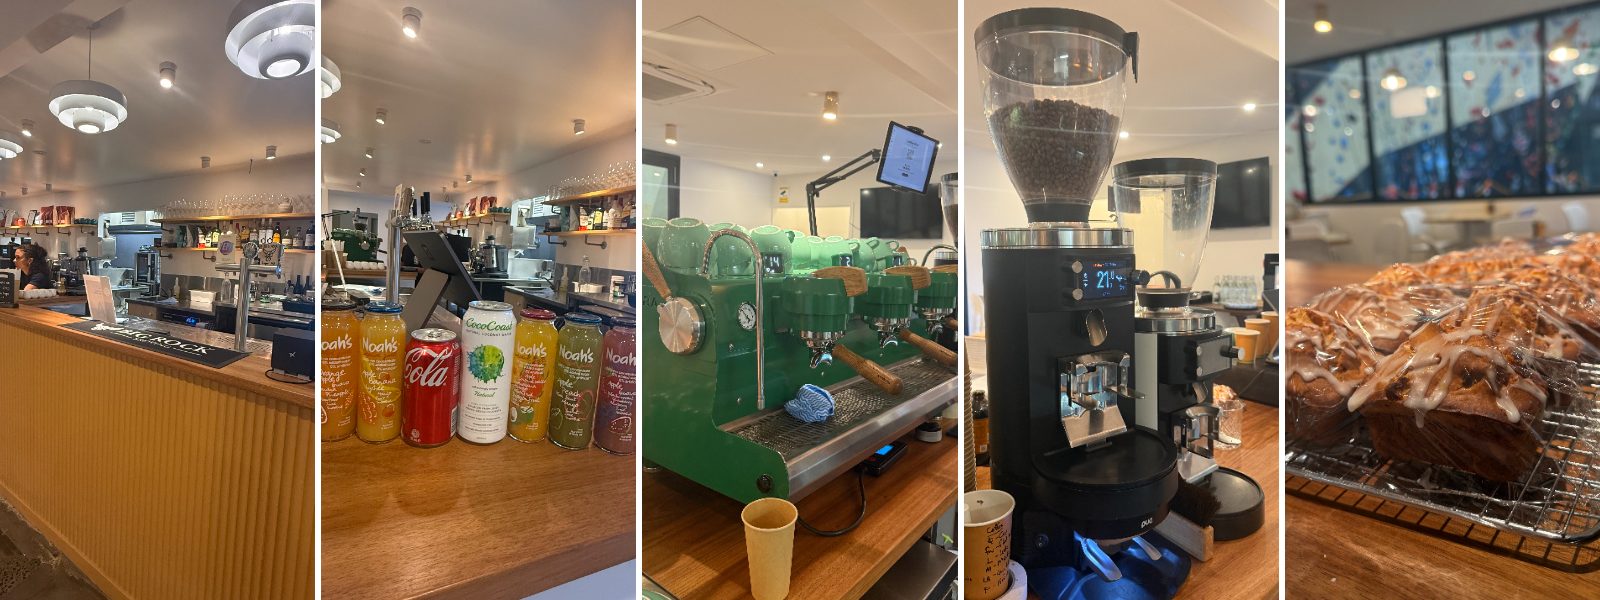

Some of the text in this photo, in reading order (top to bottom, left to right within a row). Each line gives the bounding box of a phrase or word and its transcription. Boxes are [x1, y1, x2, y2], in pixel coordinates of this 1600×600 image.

[465, 317, 513, 332] CocoCoast
[150, 336, 215, 354] ROCK
[321, 333, 352, 351] oah's
[362, 336, 398, 353] Noah's
[559, 344, 594, 363] Noah's
[404, 347, 453, 387] Cola
[473, 390, 496, 398] Natural
